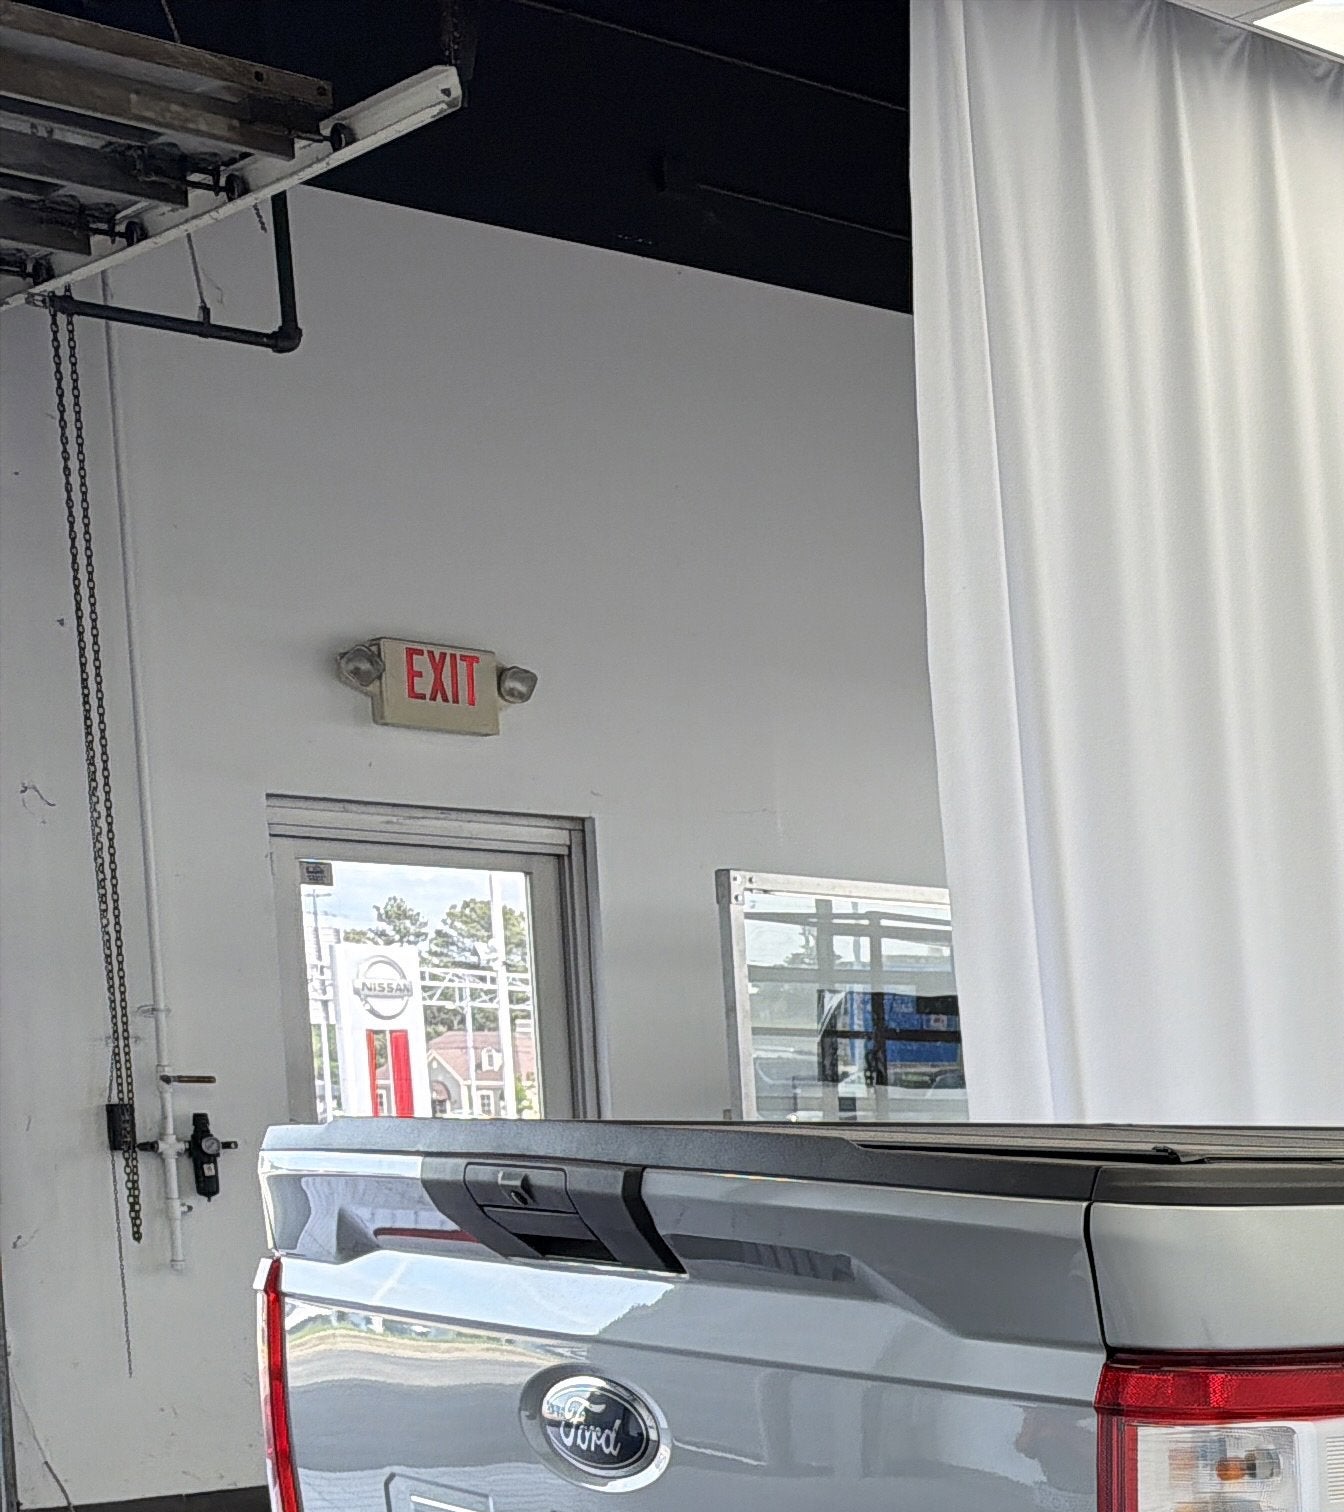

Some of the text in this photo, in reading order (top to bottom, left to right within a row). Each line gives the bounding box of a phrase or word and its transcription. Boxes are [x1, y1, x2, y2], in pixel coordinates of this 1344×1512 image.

[405, 647, 480, 706] EXIT
[361, 981, 410, 994] NISSAN
[560, 1396, 621, 1457] Ford
